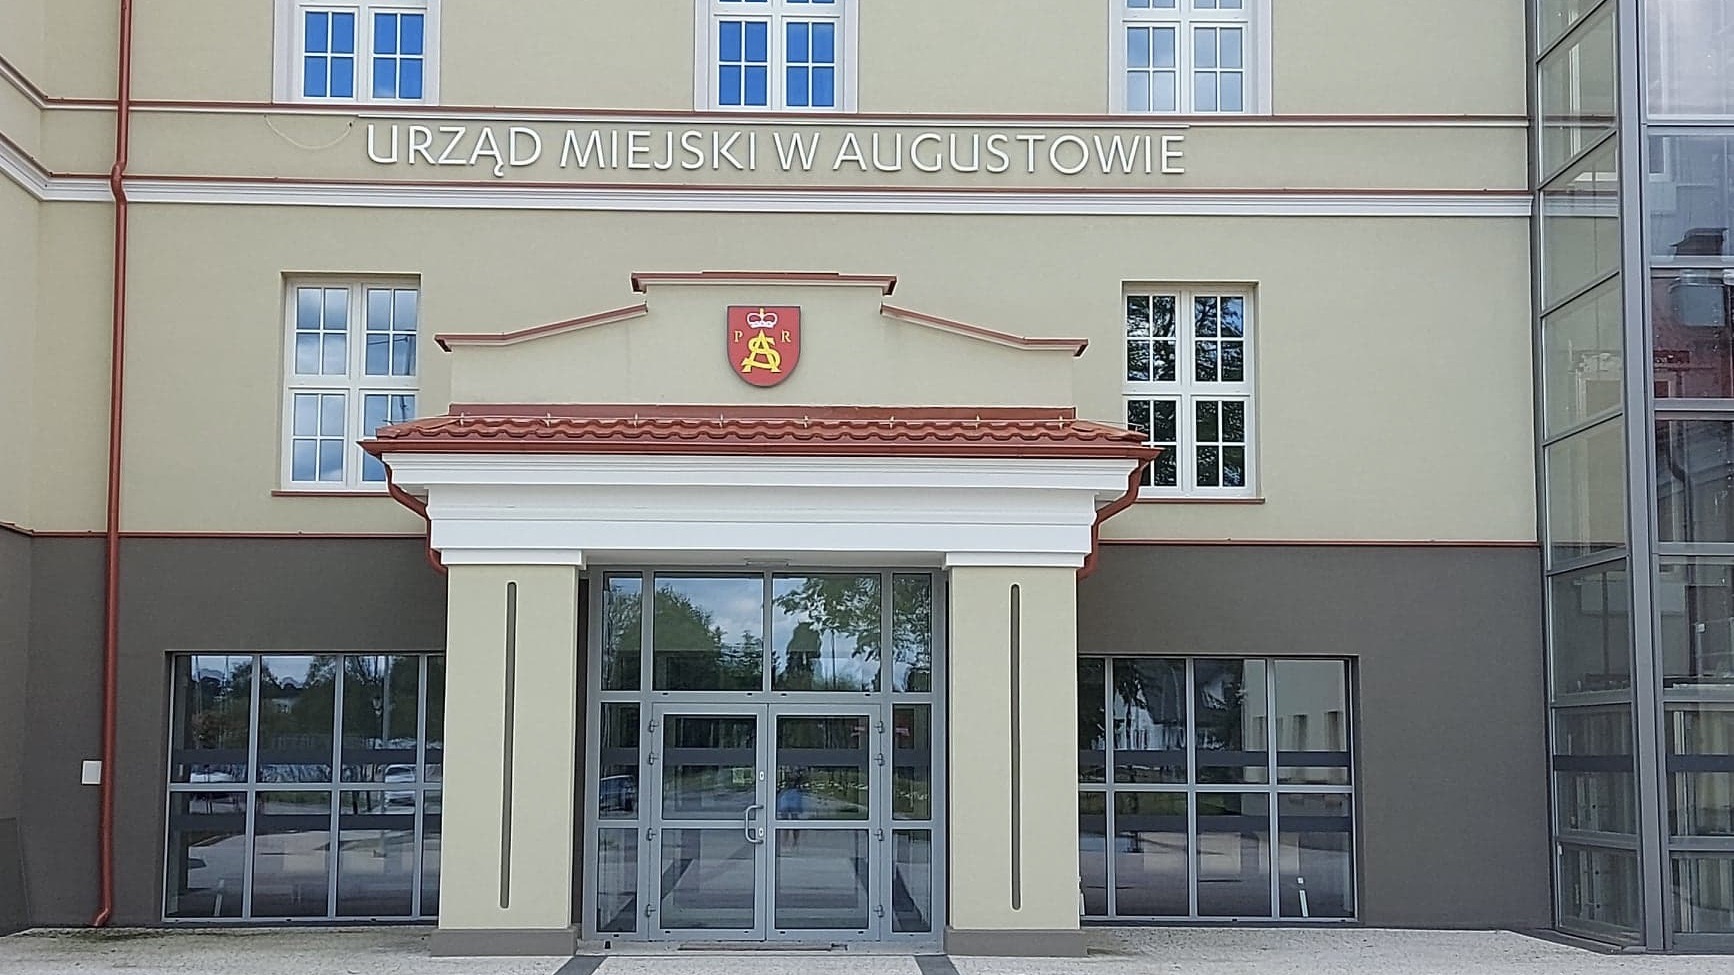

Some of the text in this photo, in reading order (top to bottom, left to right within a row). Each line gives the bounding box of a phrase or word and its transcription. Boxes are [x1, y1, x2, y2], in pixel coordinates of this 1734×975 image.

[366, 123, 1186, 178] URZĄD MIEJSKI W AUGUSTOWIE
[734, 329, 792, 343] P R
